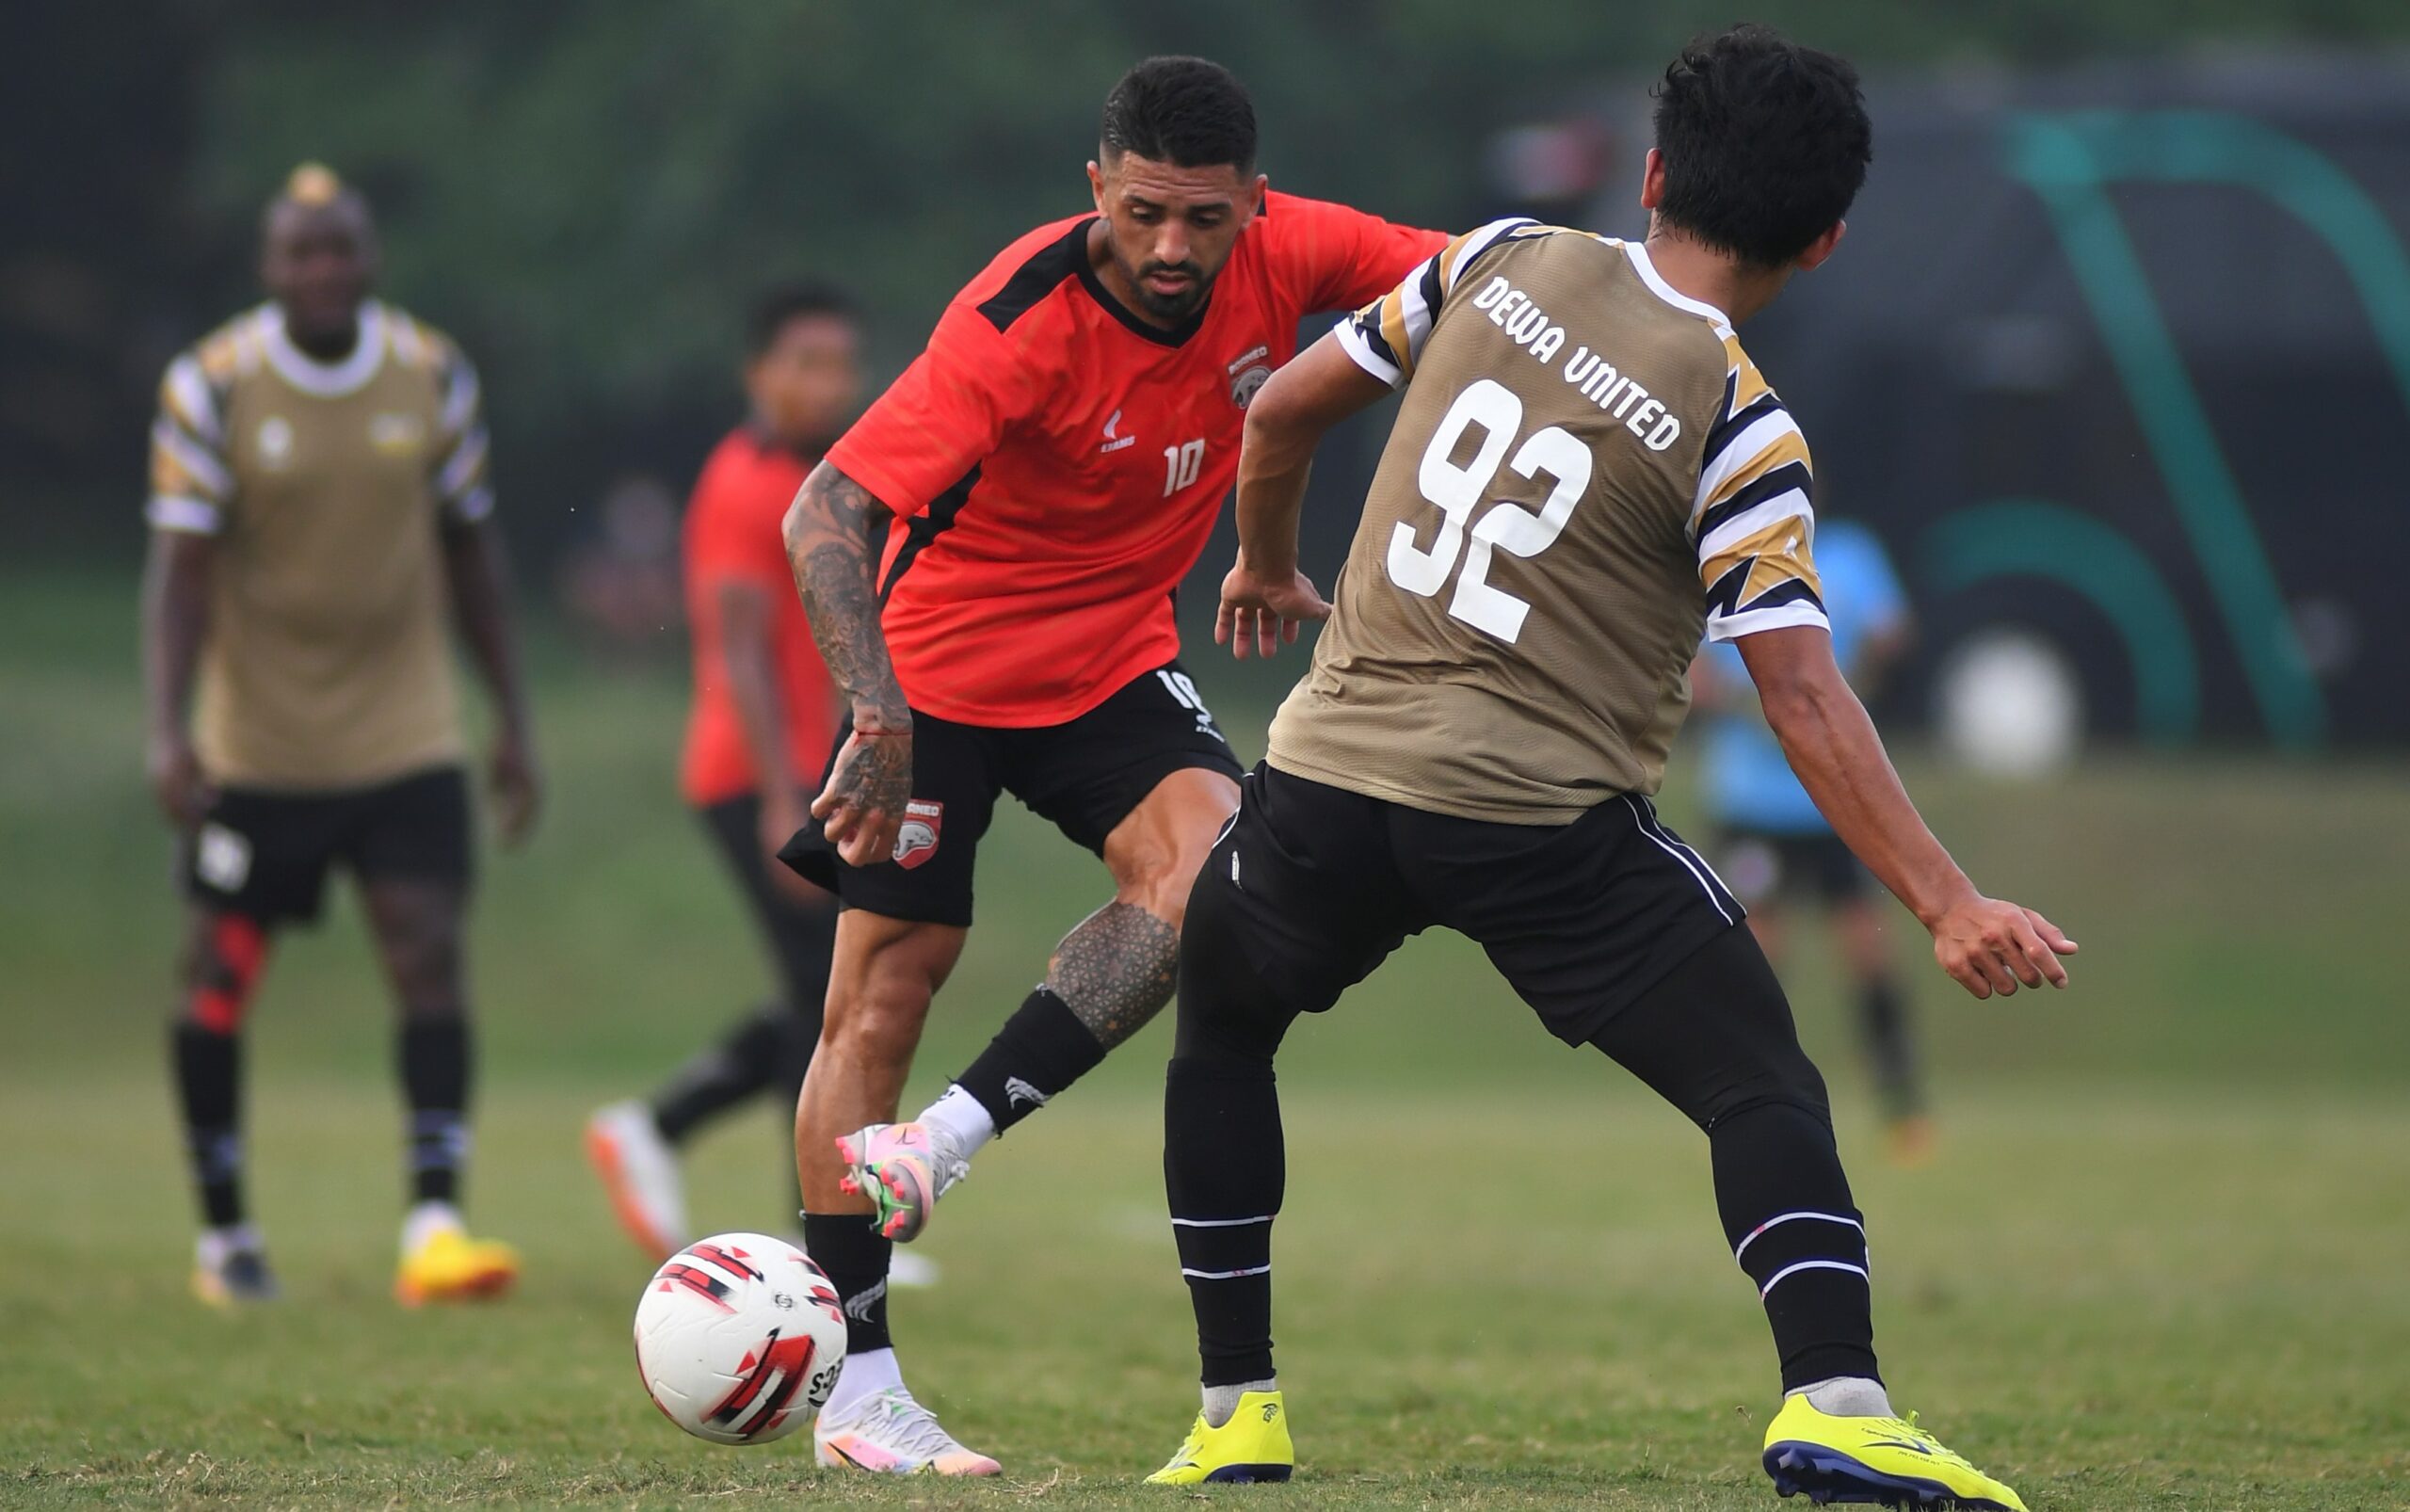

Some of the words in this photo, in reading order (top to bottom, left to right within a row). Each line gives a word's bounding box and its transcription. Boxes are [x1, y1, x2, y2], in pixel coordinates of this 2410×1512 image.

[1471, 276, 1566, 364] DEWA
[1564, 346, 1681, 451] UNITED
[1163, 438, 1206, 497] 10
[1387, 378, 1593, 644] 92
